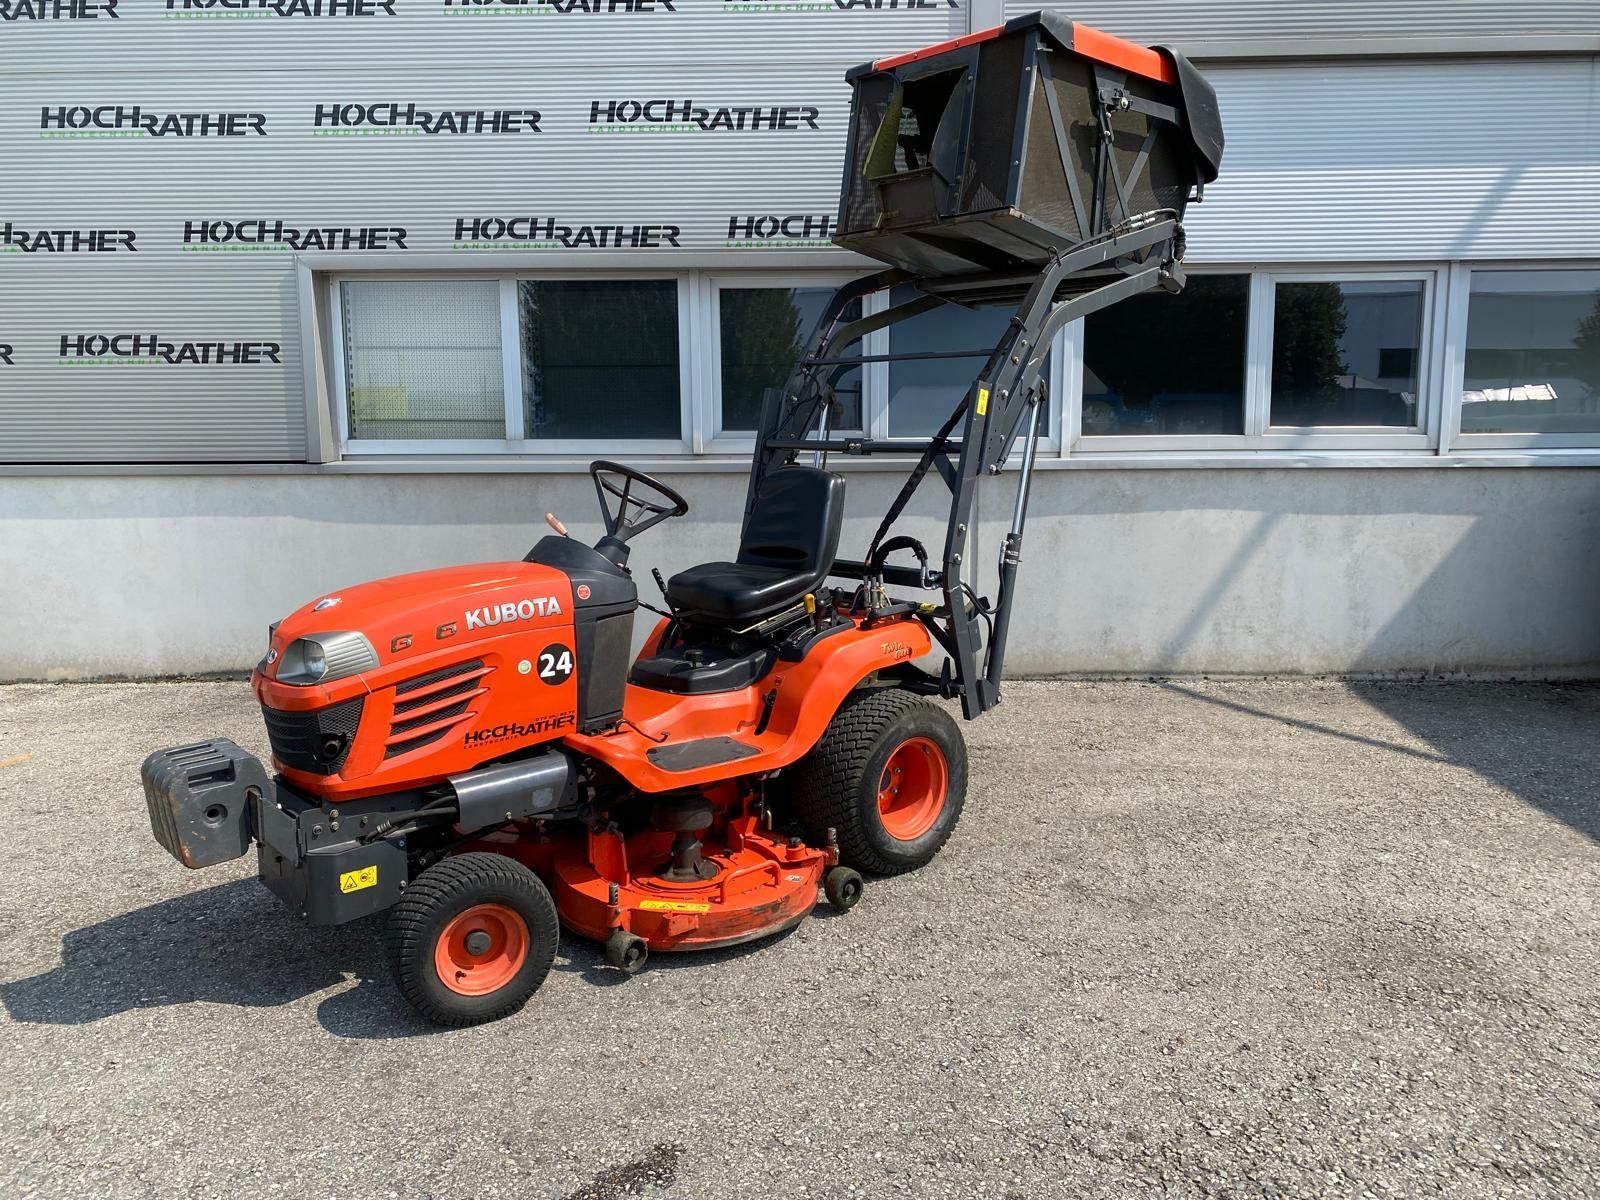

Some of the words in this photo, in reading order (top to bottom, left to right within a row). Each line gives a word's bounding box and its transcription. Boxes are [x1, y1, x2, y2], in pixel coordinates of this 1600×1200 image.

[165, 10, 274, 20] LANDTECHNIK
[443, 6, 553, 16] LANDTECHNIK
[723, 3, 833, 12] LANDTECHNIK
[41, 106, 268, 136] HOCHRATHER
[314, 104, 541, 134] HOCHRATHER
[588, 124, 697, 134] LANDTECHNIK
[590, 100, 820, 130] HOCHRATHER
[183, 221, 408, 250] HOCHRATHER
[453, 242, 561, 250] LANDTECHNIK
[455, 218, 681, 248] HOCHRATHER
[725, 240, 833, 248] LANDTECHNIK
[183, 244, 289, 252] LANDTECHNIK
[60, 335, 281, 364] HOCHRATHER
[465, 597, 563, 630] KUBOTA
[540, 651, 572, 678] 24
[464, 715, 575, 745] HOCHRATHER
